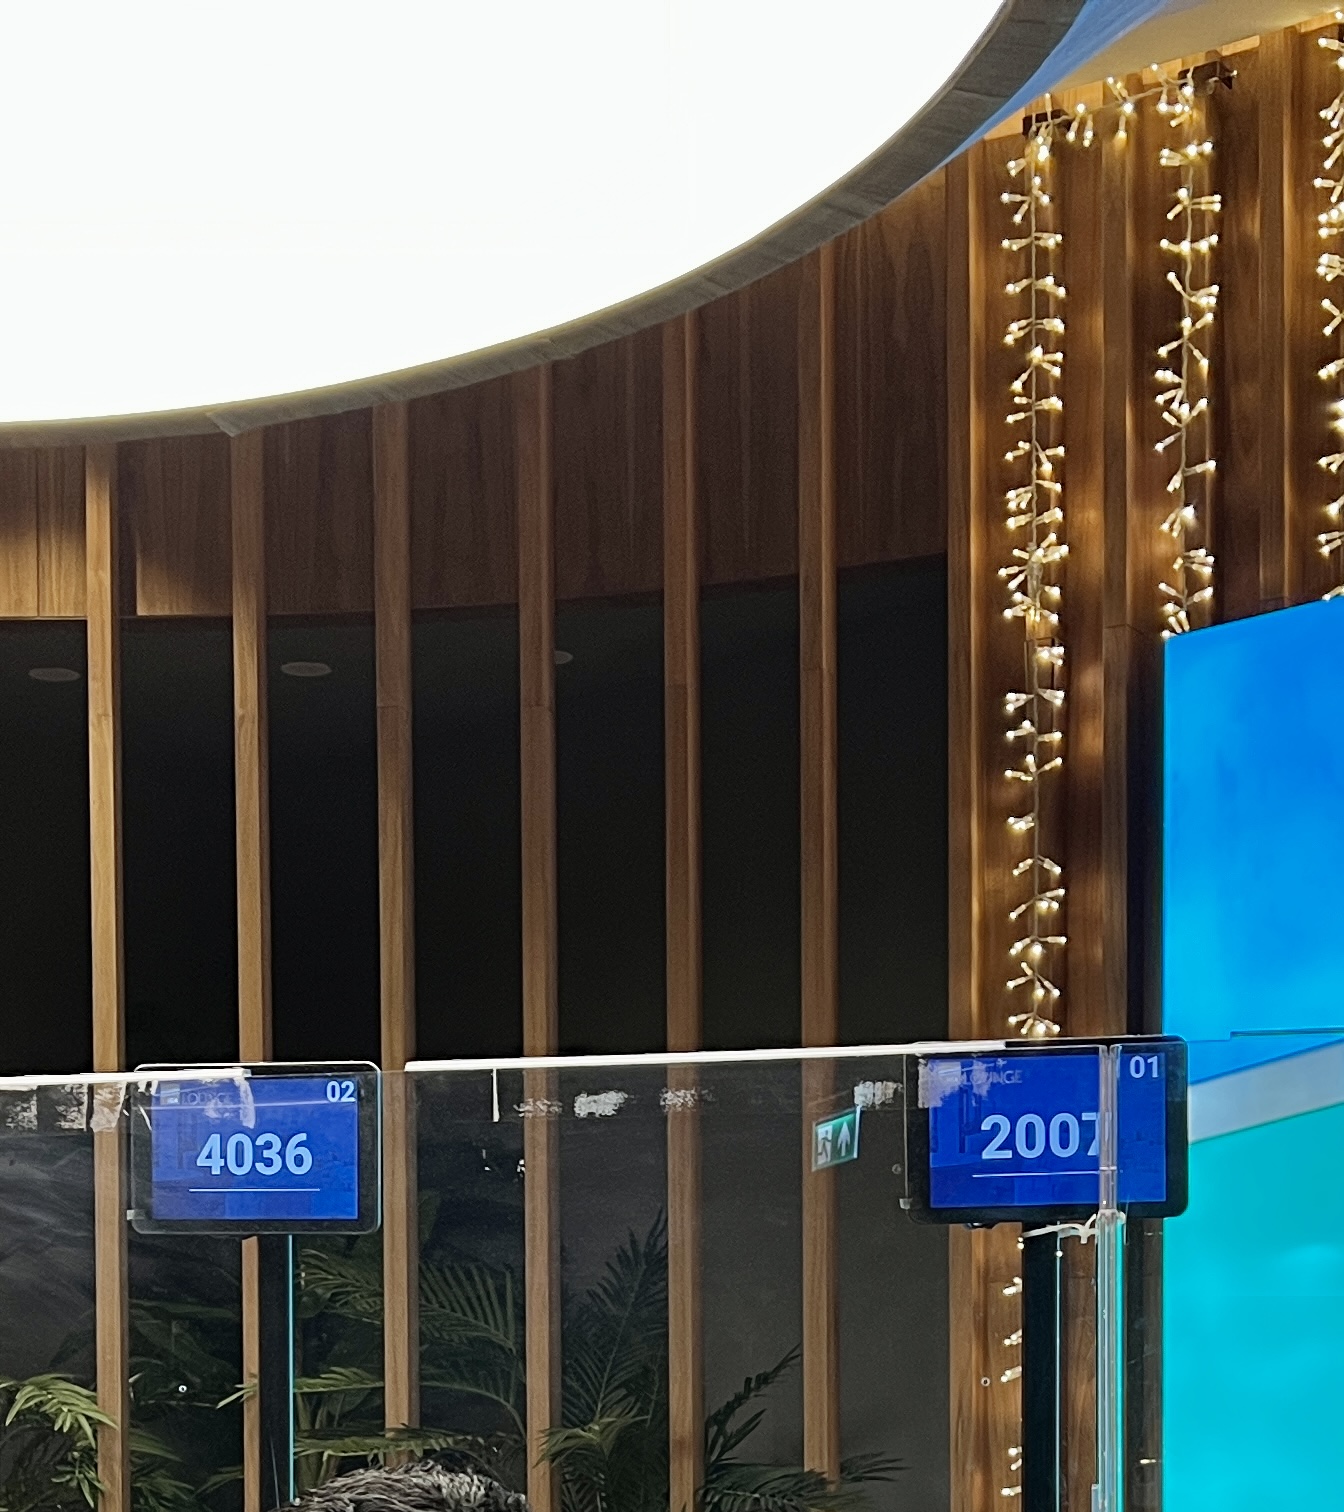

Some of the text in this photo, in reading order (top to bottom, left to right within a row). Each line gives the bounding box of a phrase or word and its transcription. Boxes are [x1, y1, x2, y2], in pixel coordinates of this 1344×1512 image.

[1129, 1055, 1160, 1079] 01
[326, 1080, 357, 1103] 02
[980, 1112, 1113, 1160] 2007
[196, 1132, 314, 1176] 4036
